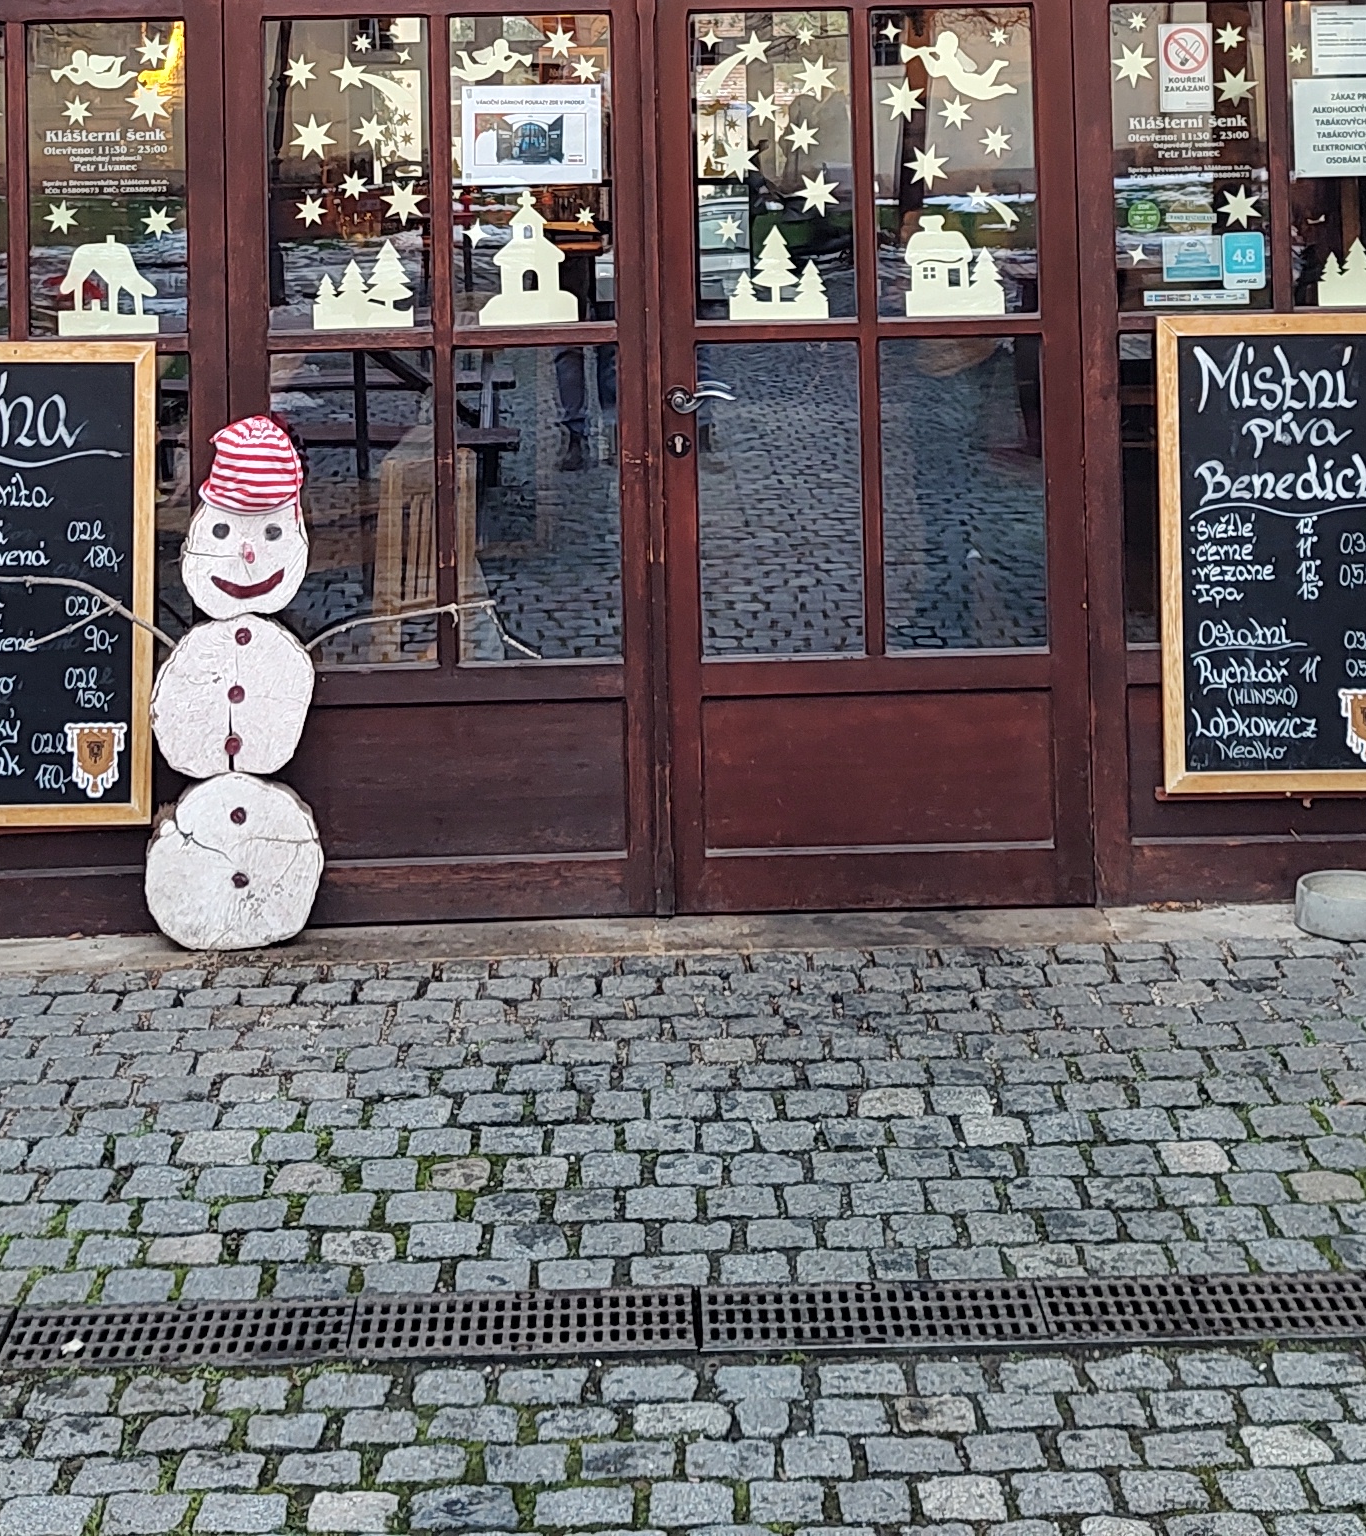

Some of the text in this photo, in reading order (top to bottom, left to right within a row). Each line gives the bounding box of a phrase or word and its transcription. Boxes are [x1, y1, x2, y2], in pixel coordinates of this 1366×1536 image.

[1168, 75, 1206, 83] KOUŘENÍ
[1164, 84, 1210, 92] ZAKÁZÁNO
[1331, 92, 1355, 100] ZÁKAZ
[1128, 114, 1248, 130] Klášterní šenk
[1315, 117, 1366, 126] TABÁKOVÝCH
[45, 128, 166, 143] Klášterní šenk
[1128, 133, 1178, 142] Otevřeno:
[1181, 132, 1209, 141] 11:30
[1219, 131, 1250, 140] 23:00
[43, 146, 94, 155] Otevřeno:
[98, 145, 127, 154] 11:30
[137, 145, 168, 154] 23:00
[1157, 150, 1179, 159] Petr
[1326, 155, 1360, 164] OSOBÁM
[73, 164, 96, 172] Petr
[1232, 249, 1256, 265] 4,8
[1190, 707, 1318, 740] Lobkowicz
[1215, 740, 1288, 760] Nealko
